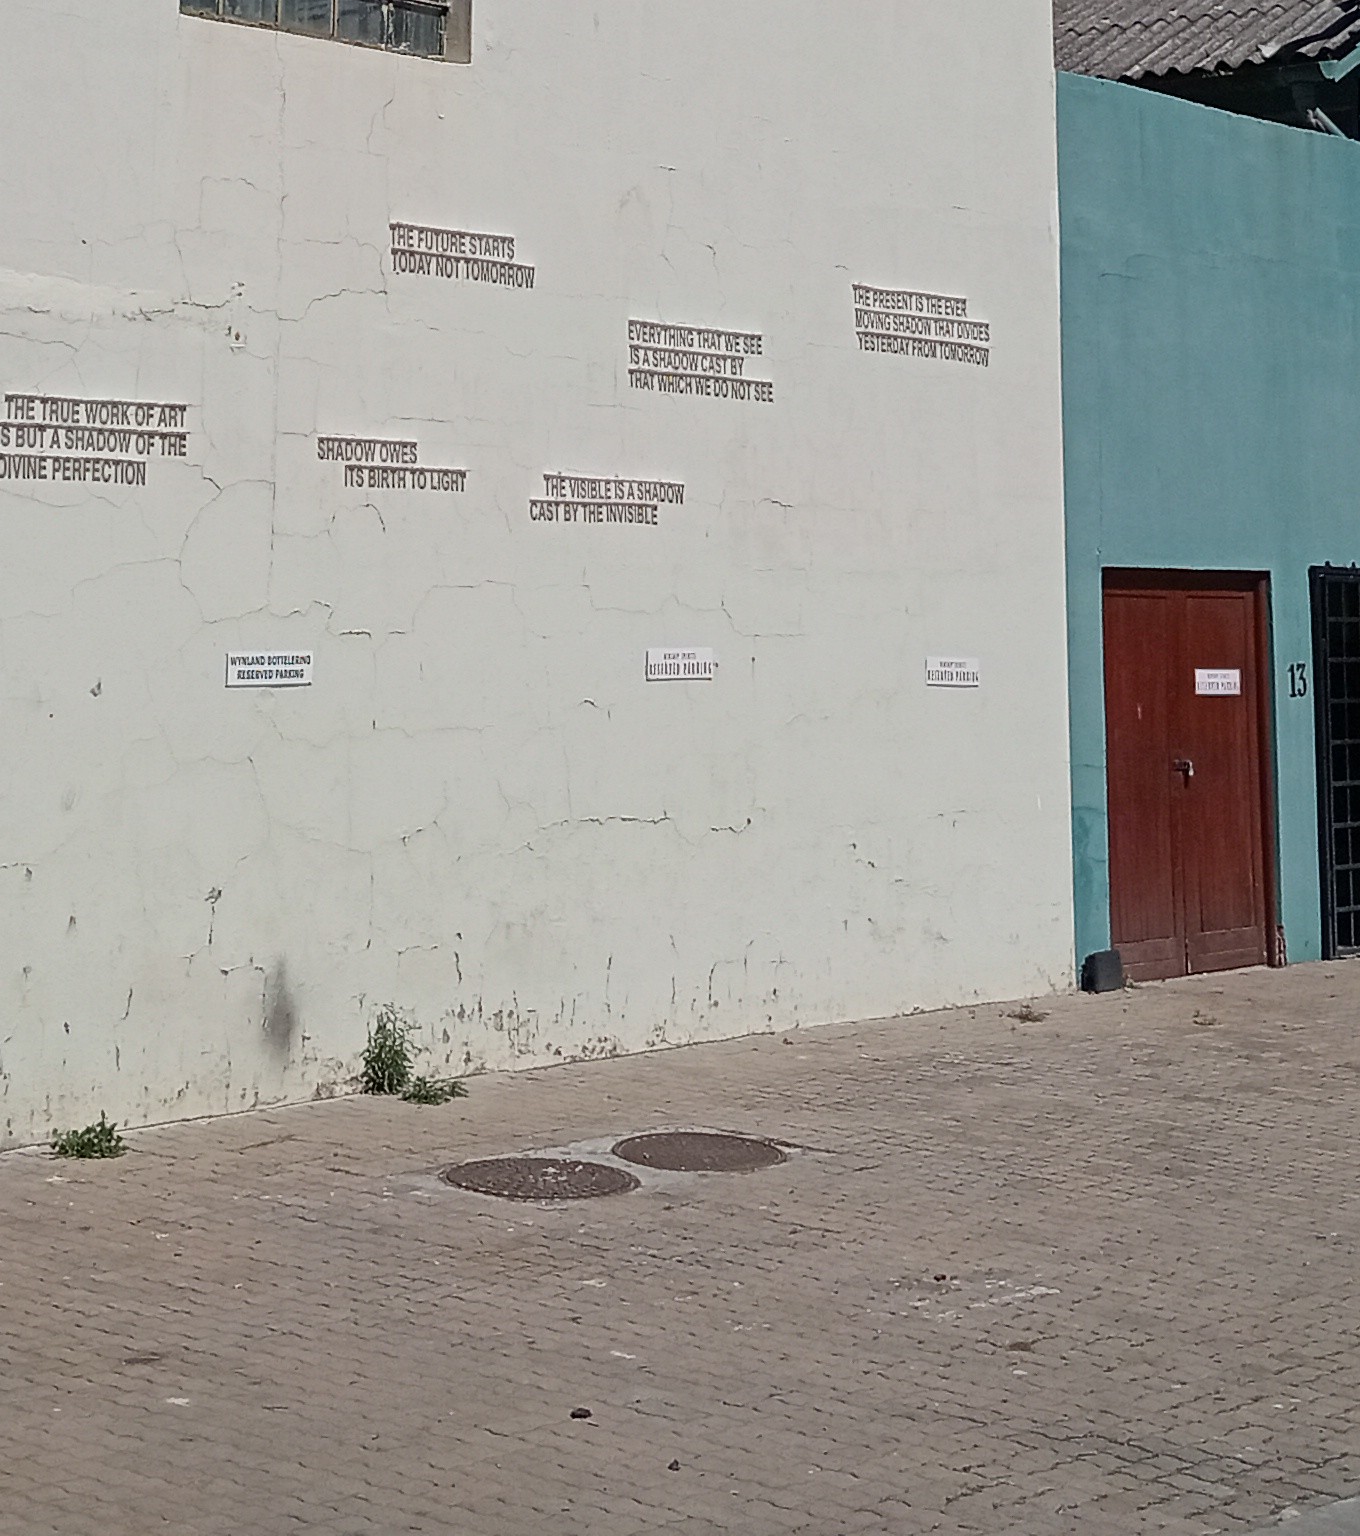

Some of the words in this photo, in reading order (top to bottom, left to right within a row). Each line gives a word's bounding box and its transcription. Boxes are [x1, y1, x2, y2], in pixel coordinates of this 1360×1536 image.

[389, 225, 414, 247] THE
[417, 229, 466, 254] FUTURE
[468, 234, 515, 260] STARTS
[391, 250, 432, 276] TODAY
[435, 255, 460, 279] NOT
[464, 259, 535, 289] TOMORROW
[853, 286, 871, 307] THE
[872, 289, 912, 311] PRESENT
[915, 293, 924, 312] IS
[926, 295, 943, 315] THE
[945, 297, 967, 318] EVER
[628, 321, 694, 348] EVERYTHING
[696, 329, 722, 351] THAT
[725, 332, 740, 352] WE
[742, 334, 763, 355] SEE
[855, 310, 891, 331] MOVING
[892, 314, 932, 336] SHADOW
[934, 318, 955, 338] THAT
[957, 321, 990, 342] DIVIDES
[629, 345, 640, 365] IS
[642, 347, 650, 366] A
[652, 348, 698, 371] SHADOW
[700, 353, 727, 375] CAST
[730, 355, 744, 377] BY
[856, 332, 910, 356] YESTERDAY
[911, 338, 937, 359] FROM
[939, 341, 989, 367] TOMORROW
[628, 370, 654, 391] THAT
[657, 372, 693, 394] WHICH
[695, 375, 711, 396] WE
[713, 377, 728, 398] DO
[731, 379, 752, 400] NOT
[753, 382, 774, 403] SEE
[5, 396, 36, 420] THE
[40, 398, 80, 424] TRUE
[85, 401, 131, 426] WORK
[135, 403, 155, 427] OF
[157, 404, 187, 428] ART
[15, 425, 45, 448] BUT
[49, 427, 61, 449] A
[64, 427, 131, 453] SHADOW
[136, 431, 155, 455] OF
[159, 432, 187, 457] THE
[317, 437, 376, 462] SHADOW
[380, 440, 417, 464] OWES
[52, 456, 146, 486] PERFECTION
[345, 465, 364, 487] ITS
[368, 466, 406, 490] BIRTH
[410, 468, 426, 490] TO
[430, 470, 466, 492] LIGHT
[543, 474, 567, 497] THE
[568, 478, 611, 500] VISIBLE
[614, 480, 625, 500] IS
[627, 480, 635, 500] A
[637, 481, 684, 504] SHADOW
[530, 500, 560, 522] CAST
[563, 501, 579, 522] BY
[581, 502, 604, 523] THE
[606, 503, 658, 525] INVISIBLE
[1287, 662, 1307, 698] 13
